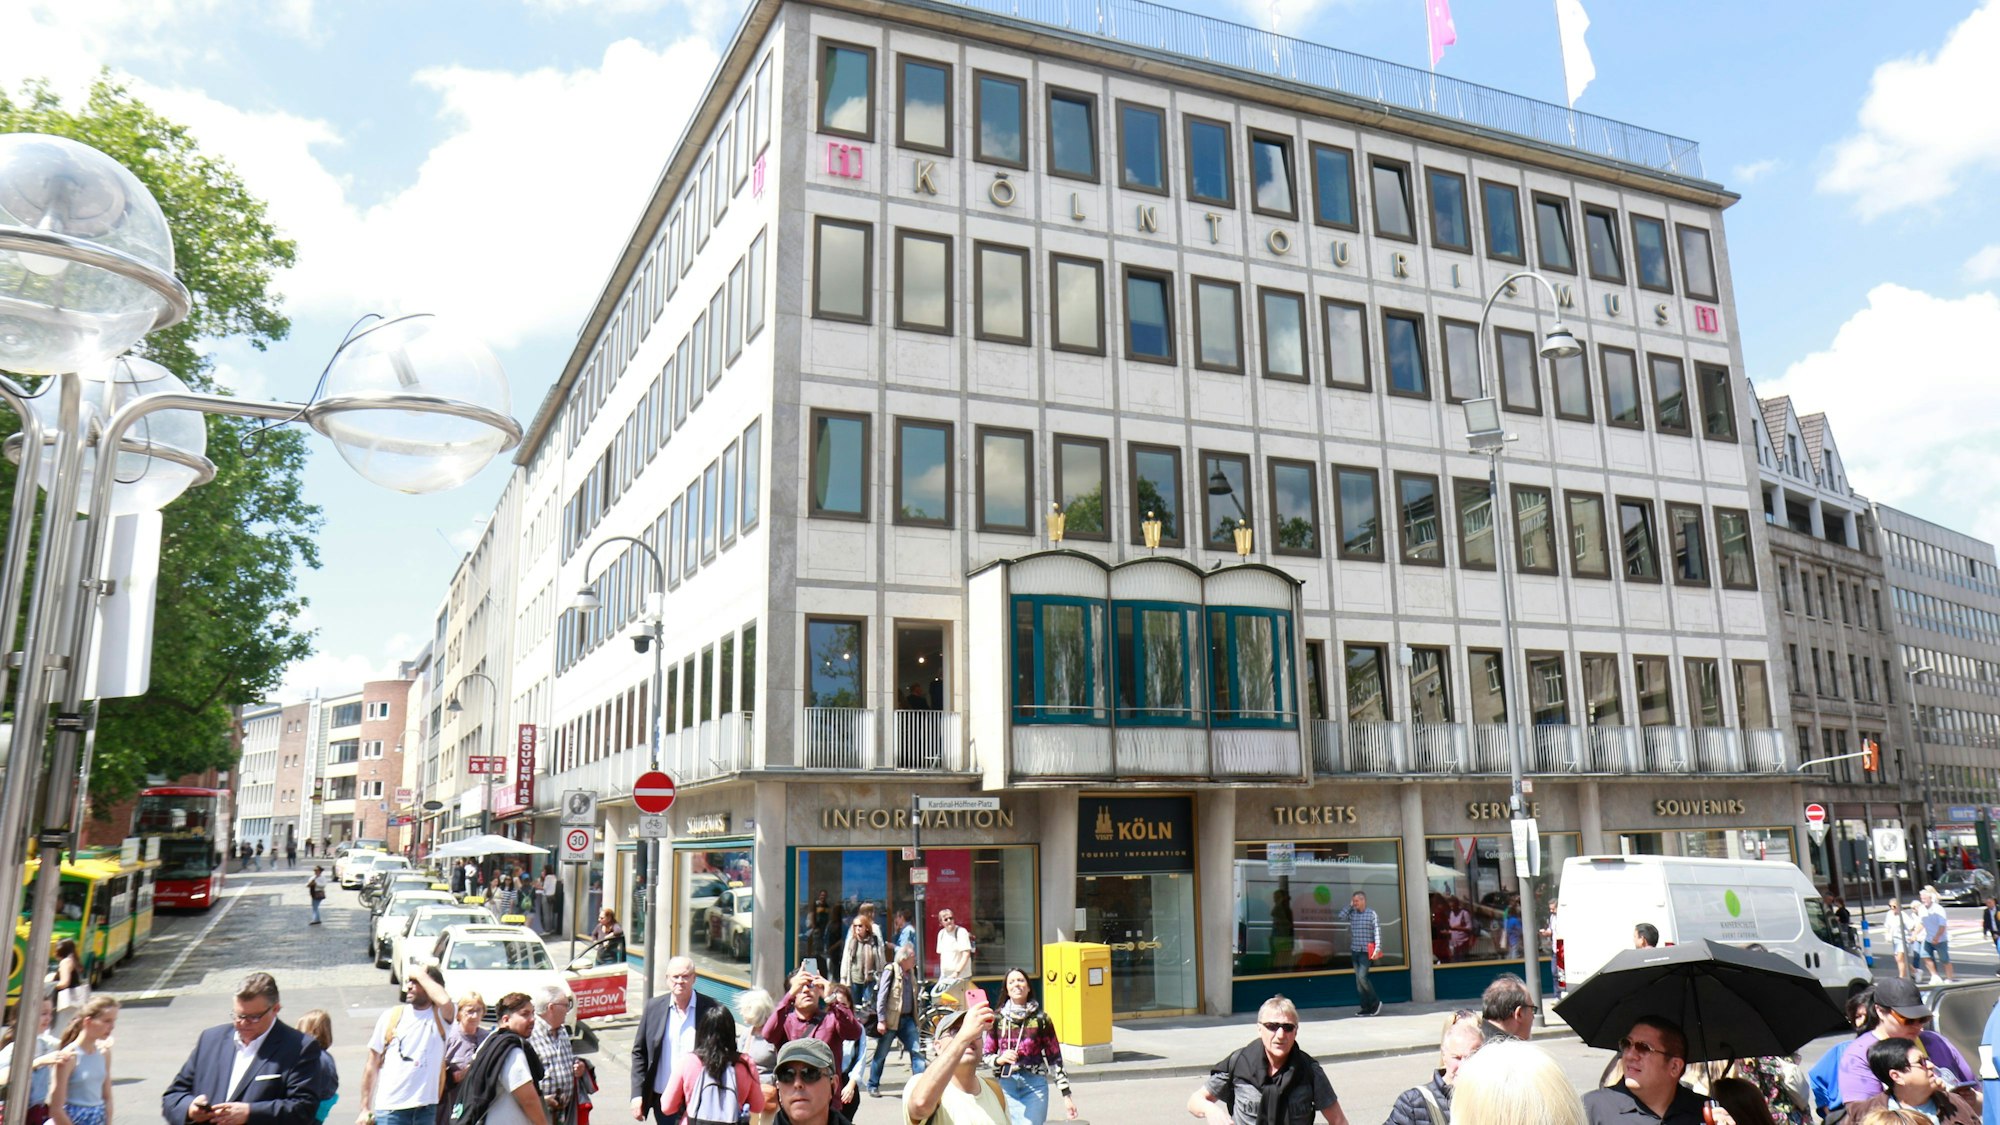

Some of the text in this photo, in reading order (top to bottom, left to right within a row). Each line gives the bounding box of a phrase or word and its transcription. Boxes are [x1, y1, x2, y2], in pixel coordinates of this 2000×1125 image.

[520, 736, 532, 804] SOUVENIRS
[928, 800, 993, 808] Kardinal-Höffner-Platz
[1469, 802, 1541, 820] SERVE
[1655, 799, 1746, 816] SOUVENIRS
[822, 808, 1014, 829] INFORMATION
[1274, 806, 1357, 825] TICKETS
[1117, 817, 1172, 841] KÖLN
[571, 835, 585, 846] 30
[1484, 850, 1513, 861] Cologne
